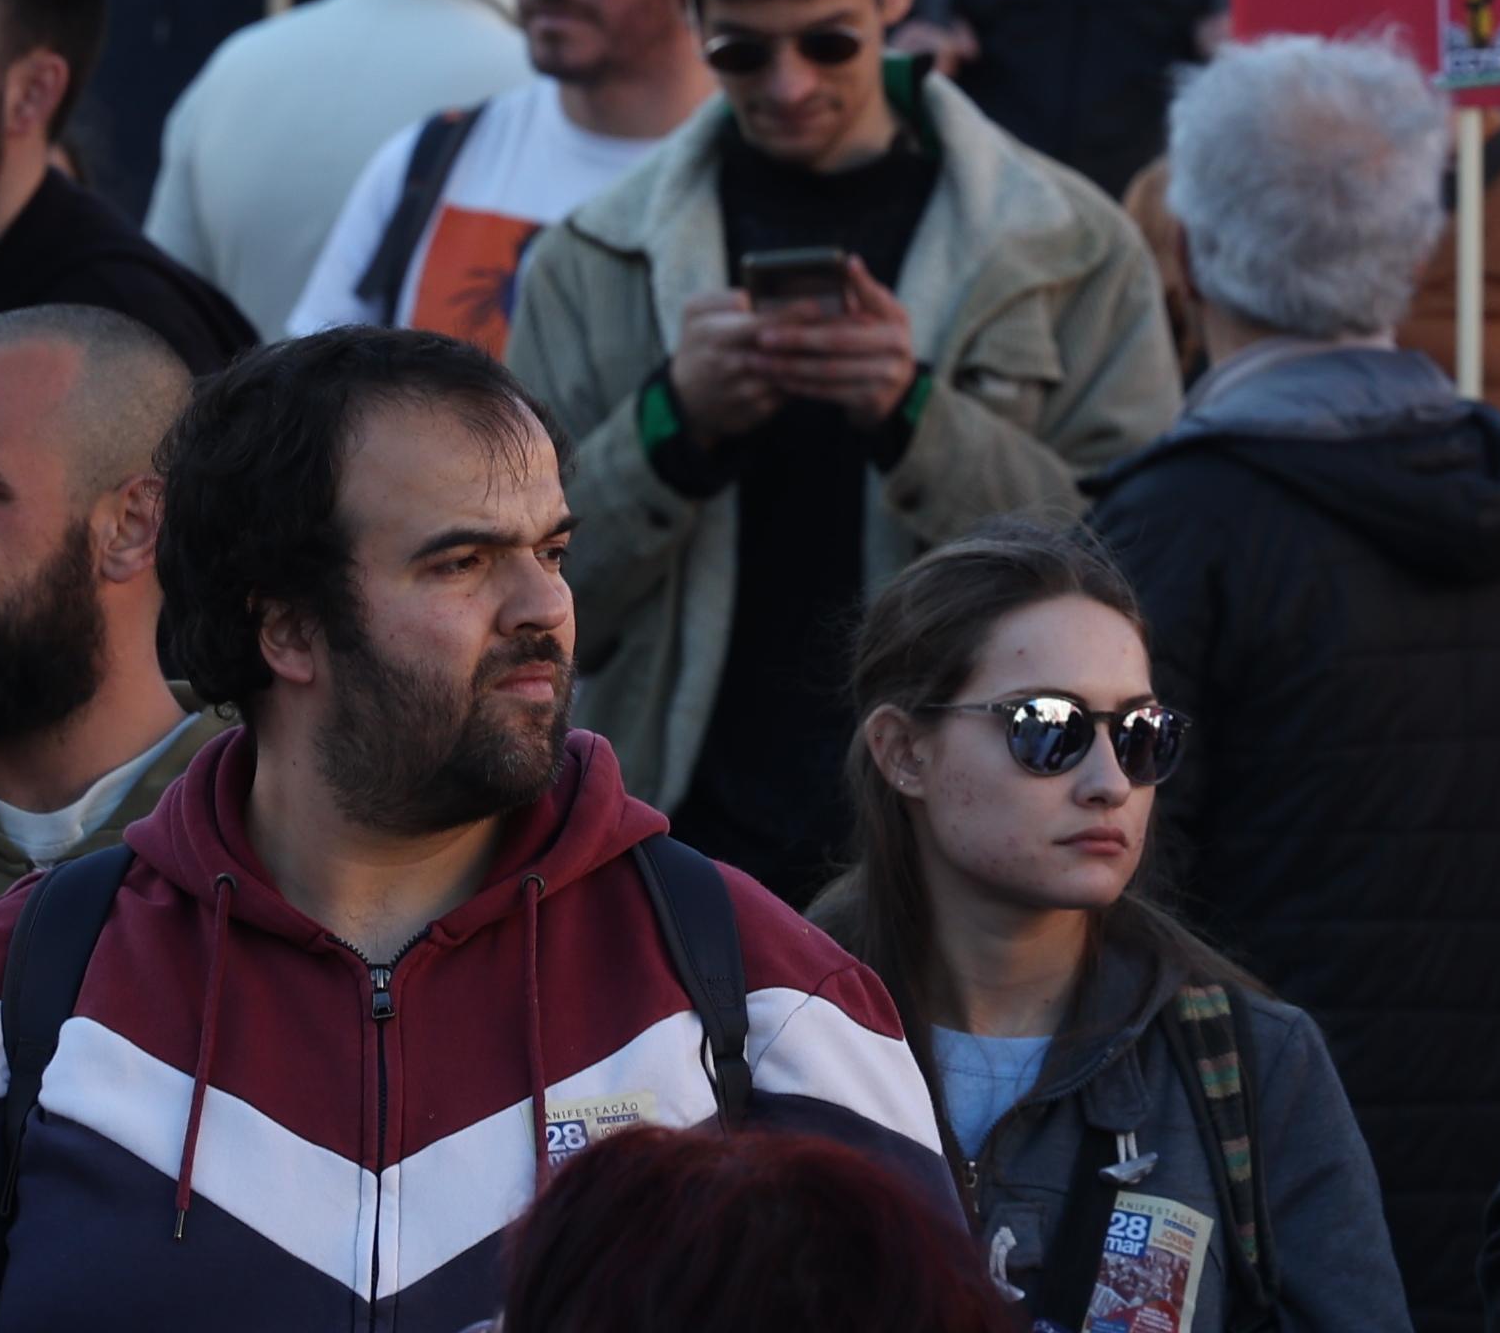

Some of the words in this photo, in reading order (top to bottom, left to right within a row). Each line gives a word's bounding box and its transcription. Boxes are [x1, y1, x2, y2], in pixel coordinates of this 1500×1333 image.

[545, 1102, 638, 1120] ANIFESTAÇÃO
[546, 1123, 586, 1151] 28
[1108, 1212, 1148, 1240] 28
[1117, 1201, 1199, 1229] ANIFESTAÇÃO
[1105, 1237, 1144, 1256] mar
